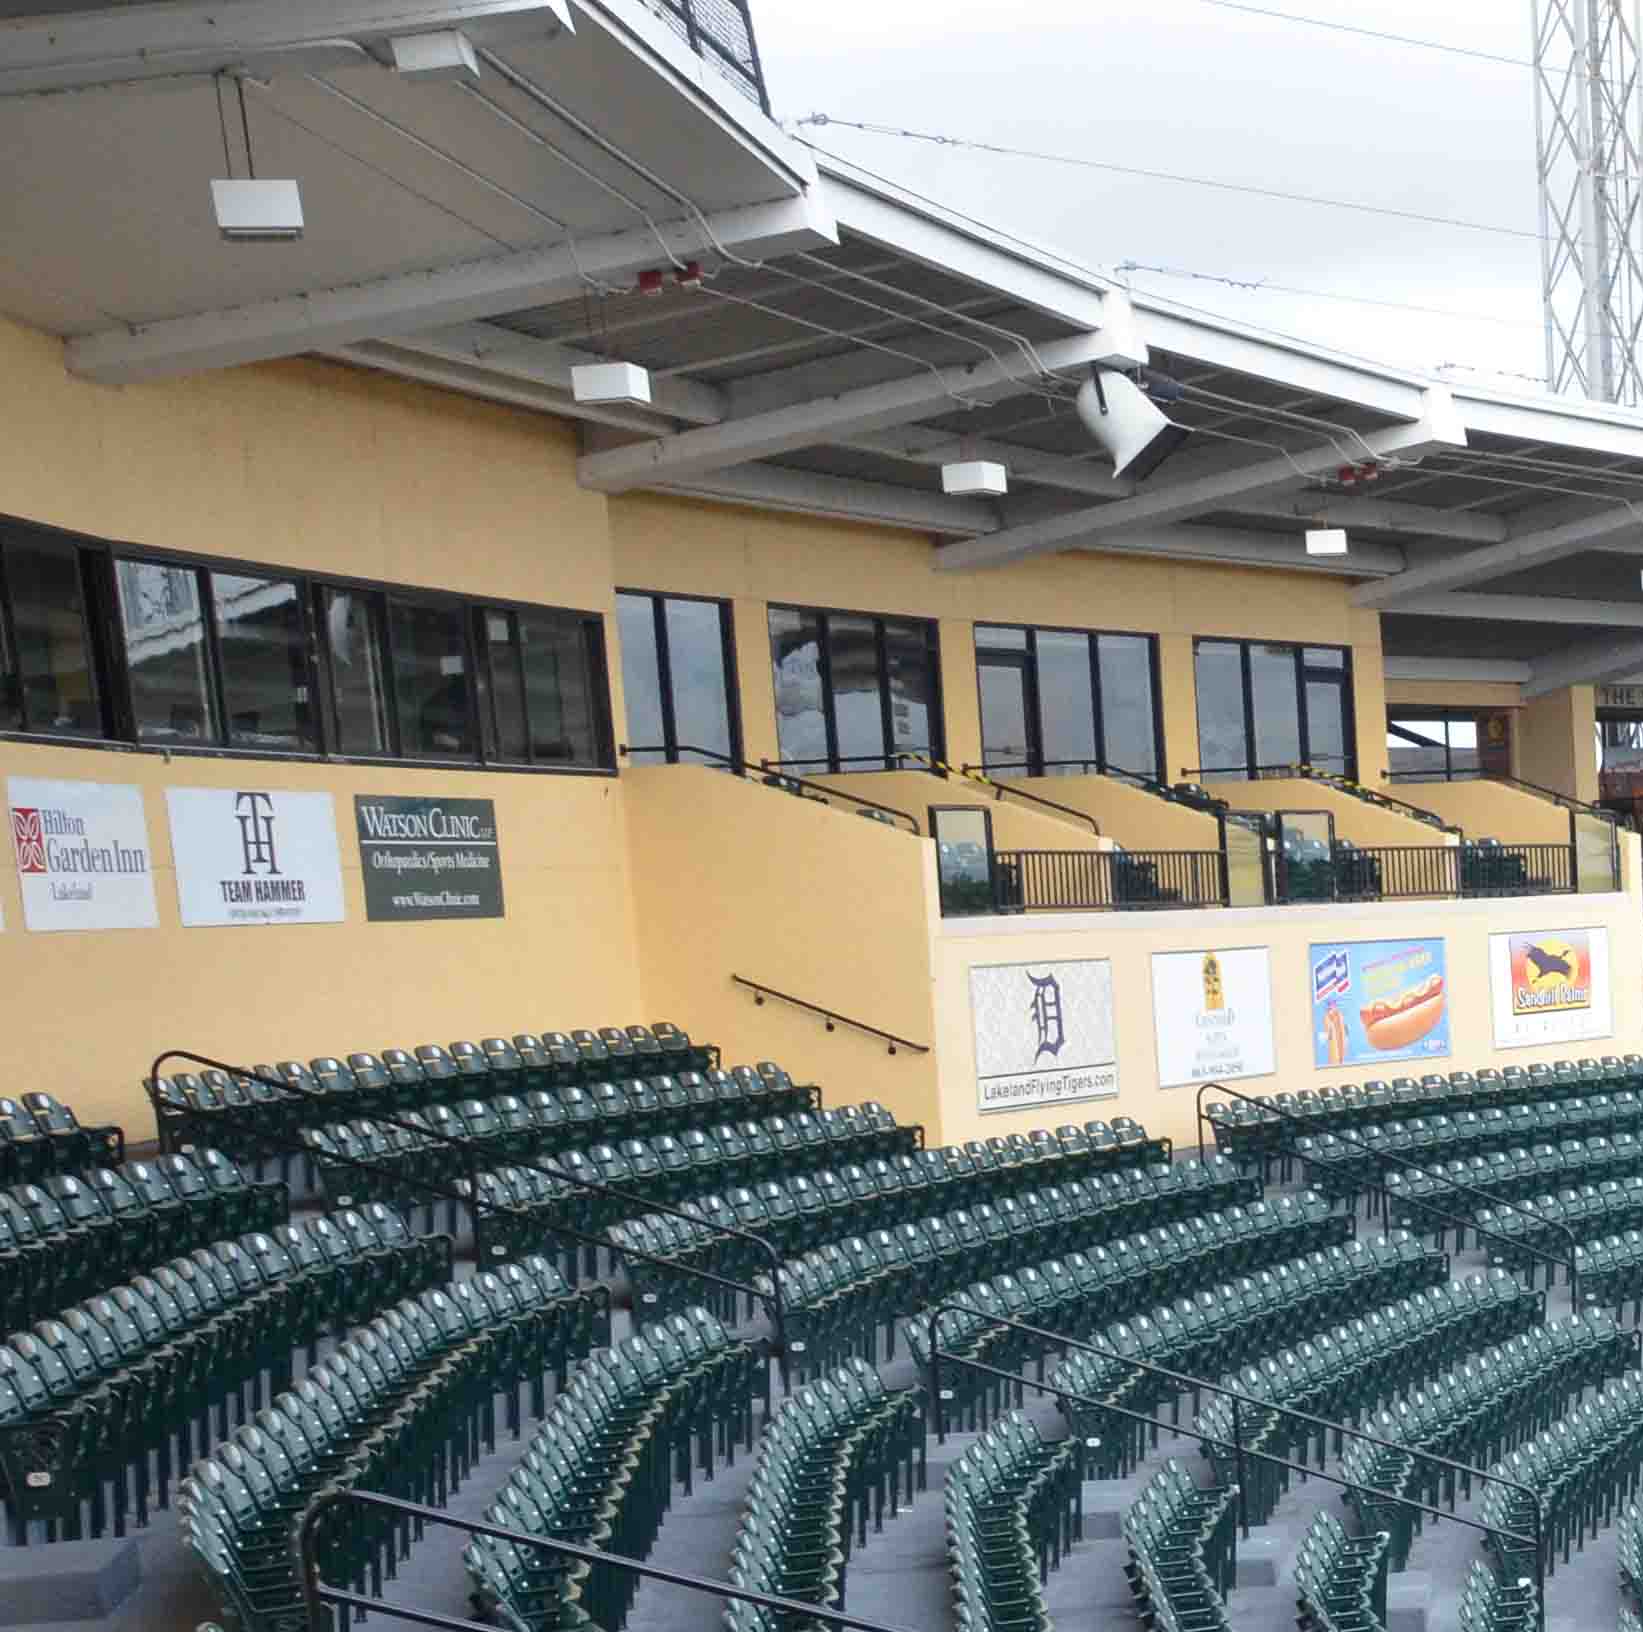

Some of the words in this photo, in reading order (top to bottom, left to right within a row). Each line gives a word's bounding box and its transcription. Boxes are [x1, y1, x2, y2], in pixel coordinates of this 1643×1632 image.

[1603, 688, 1636, 705] THE
[41, 808, 87, 836] Hilton
[429, 807, 481, 839] CLINIC
[48, 838, 113, 873] Garden
[112, 840, 146, 873] Inn
[219, 880, 252, 903] TEAM
[254, 880, 306, 902] HAMMER
